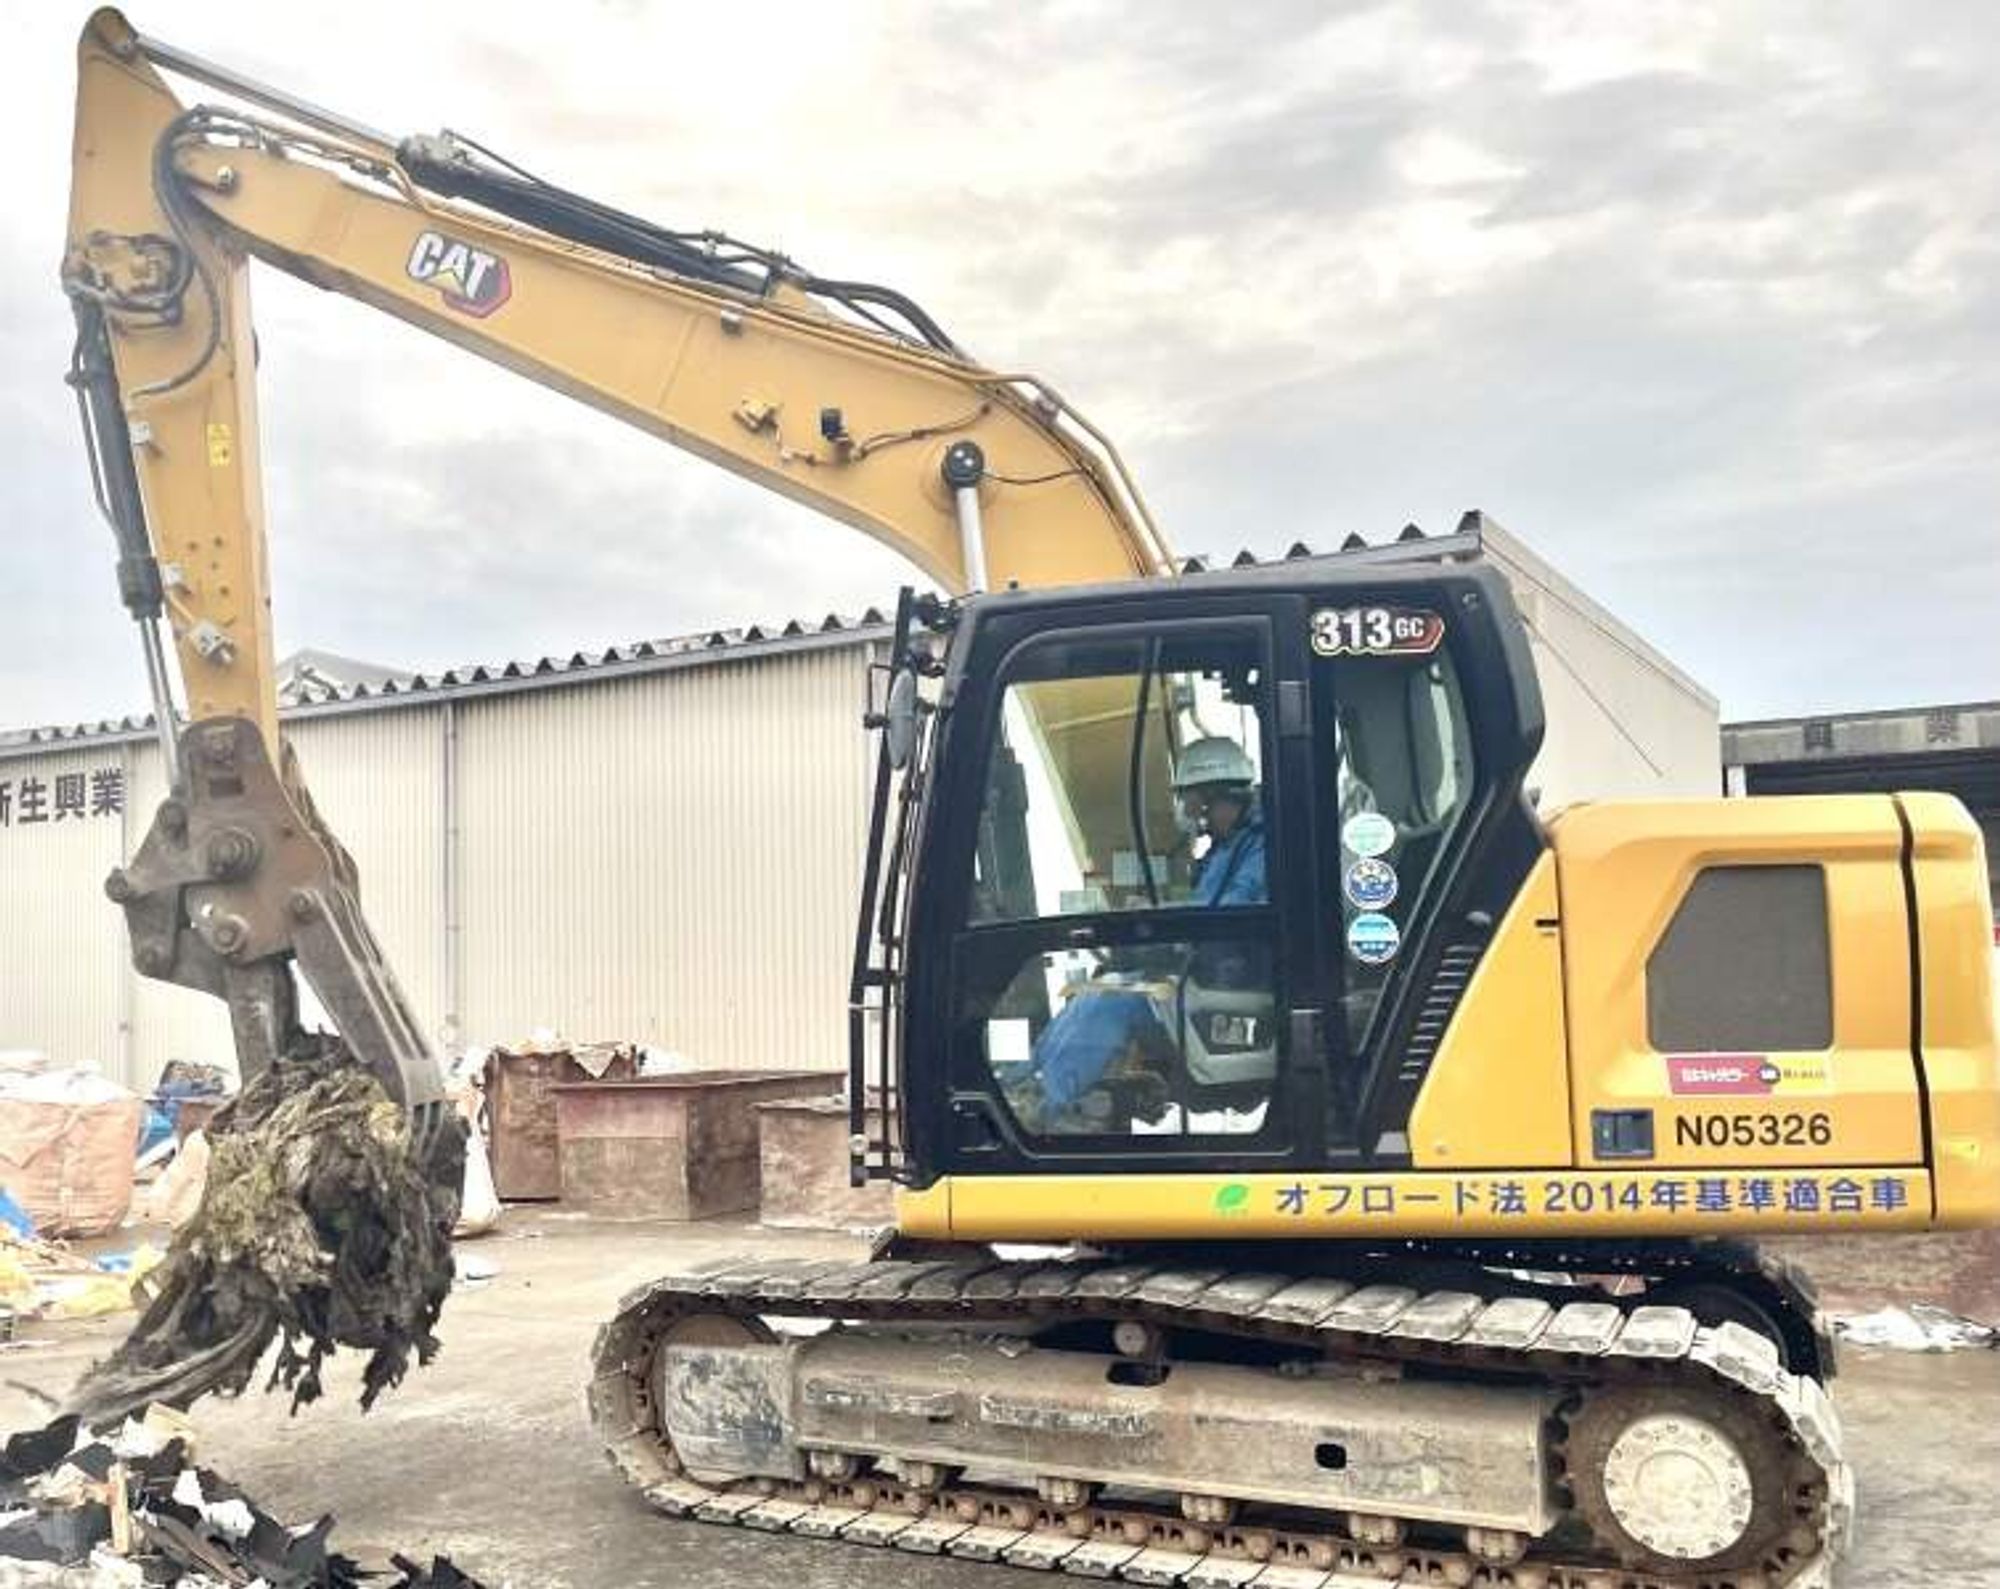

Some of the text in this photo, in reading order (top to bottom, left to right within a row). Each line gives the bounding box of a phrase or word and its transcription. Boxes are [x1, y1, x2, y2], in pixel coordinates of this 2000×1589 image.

[407, 231, 497, 300] CAT
[1314, 608, 1425, 650] 313 GC
[1211, 1014, 1257, 1047] CAT
[1675, 1113, 1831, 1147] N05326
[1275, 1177, 1909, 1216] オフロード法 2014年基準適合車
